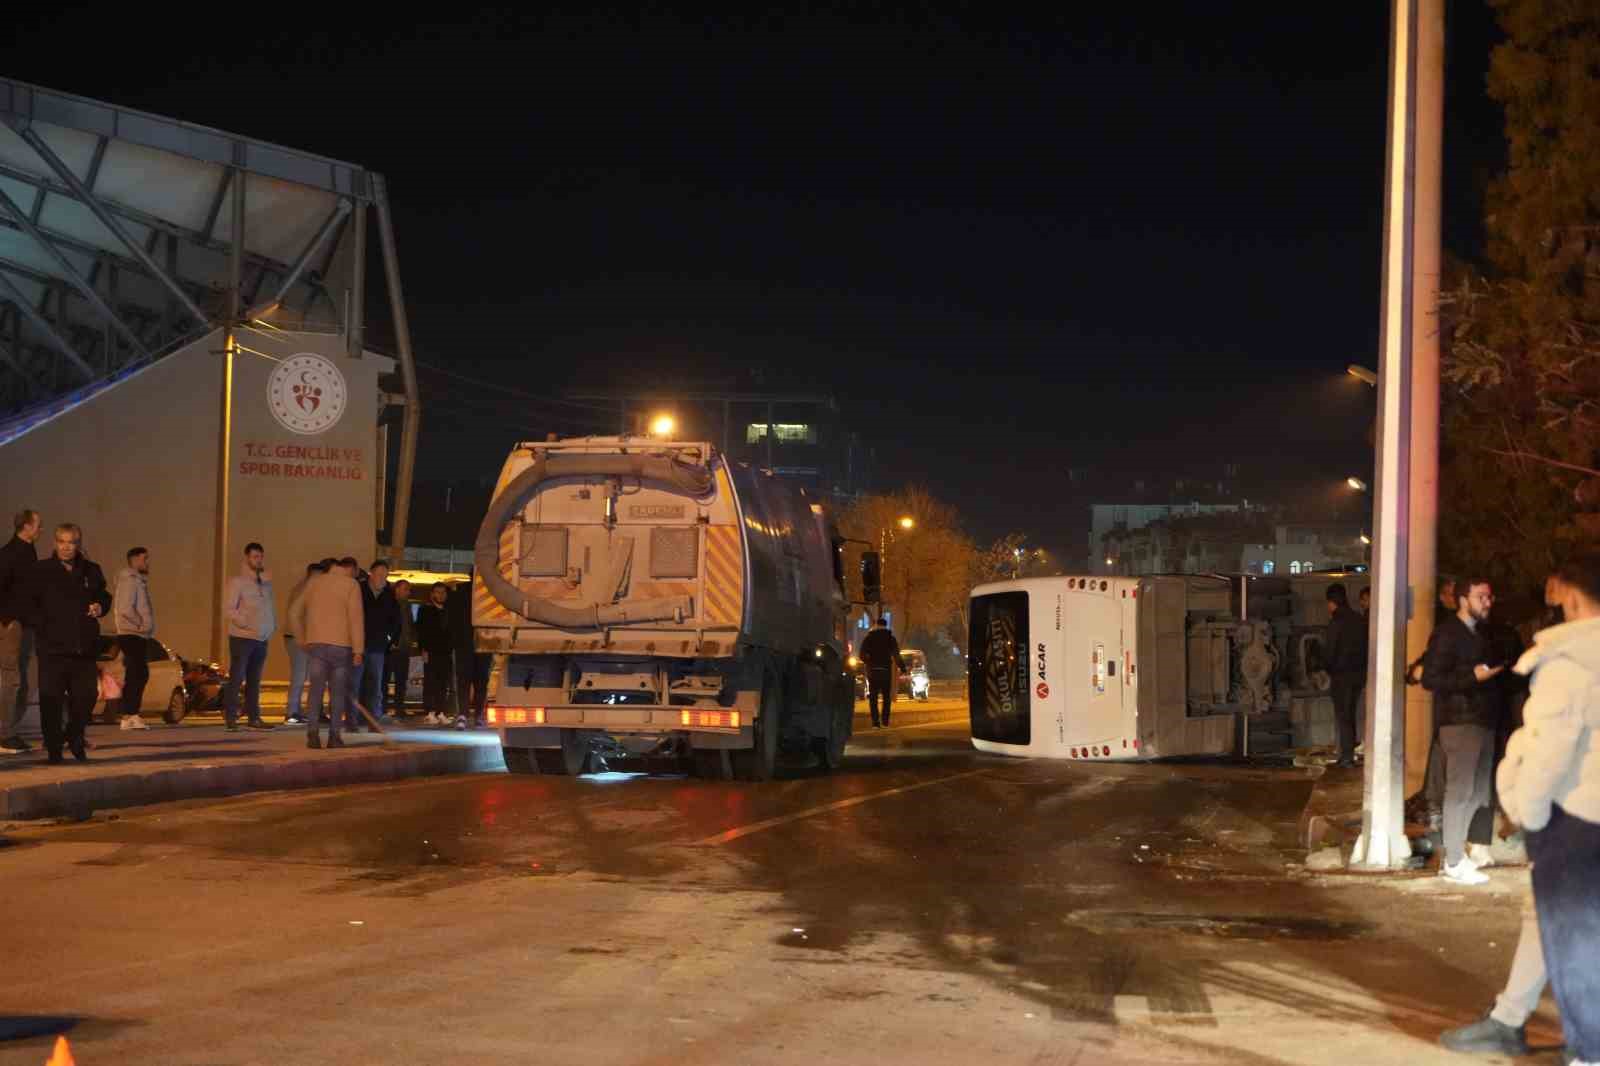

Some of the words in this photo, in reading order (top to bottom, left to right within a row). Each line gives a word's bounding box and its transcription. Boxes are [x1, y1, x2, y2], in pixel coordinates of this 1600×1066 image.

[239, 462, 280, 477] SPOR
[1018, 643, 1027, 694] ISUZU
[1037, 643, 1047, 681] ACAR
[998, 671, 1012, 713] OKUL
